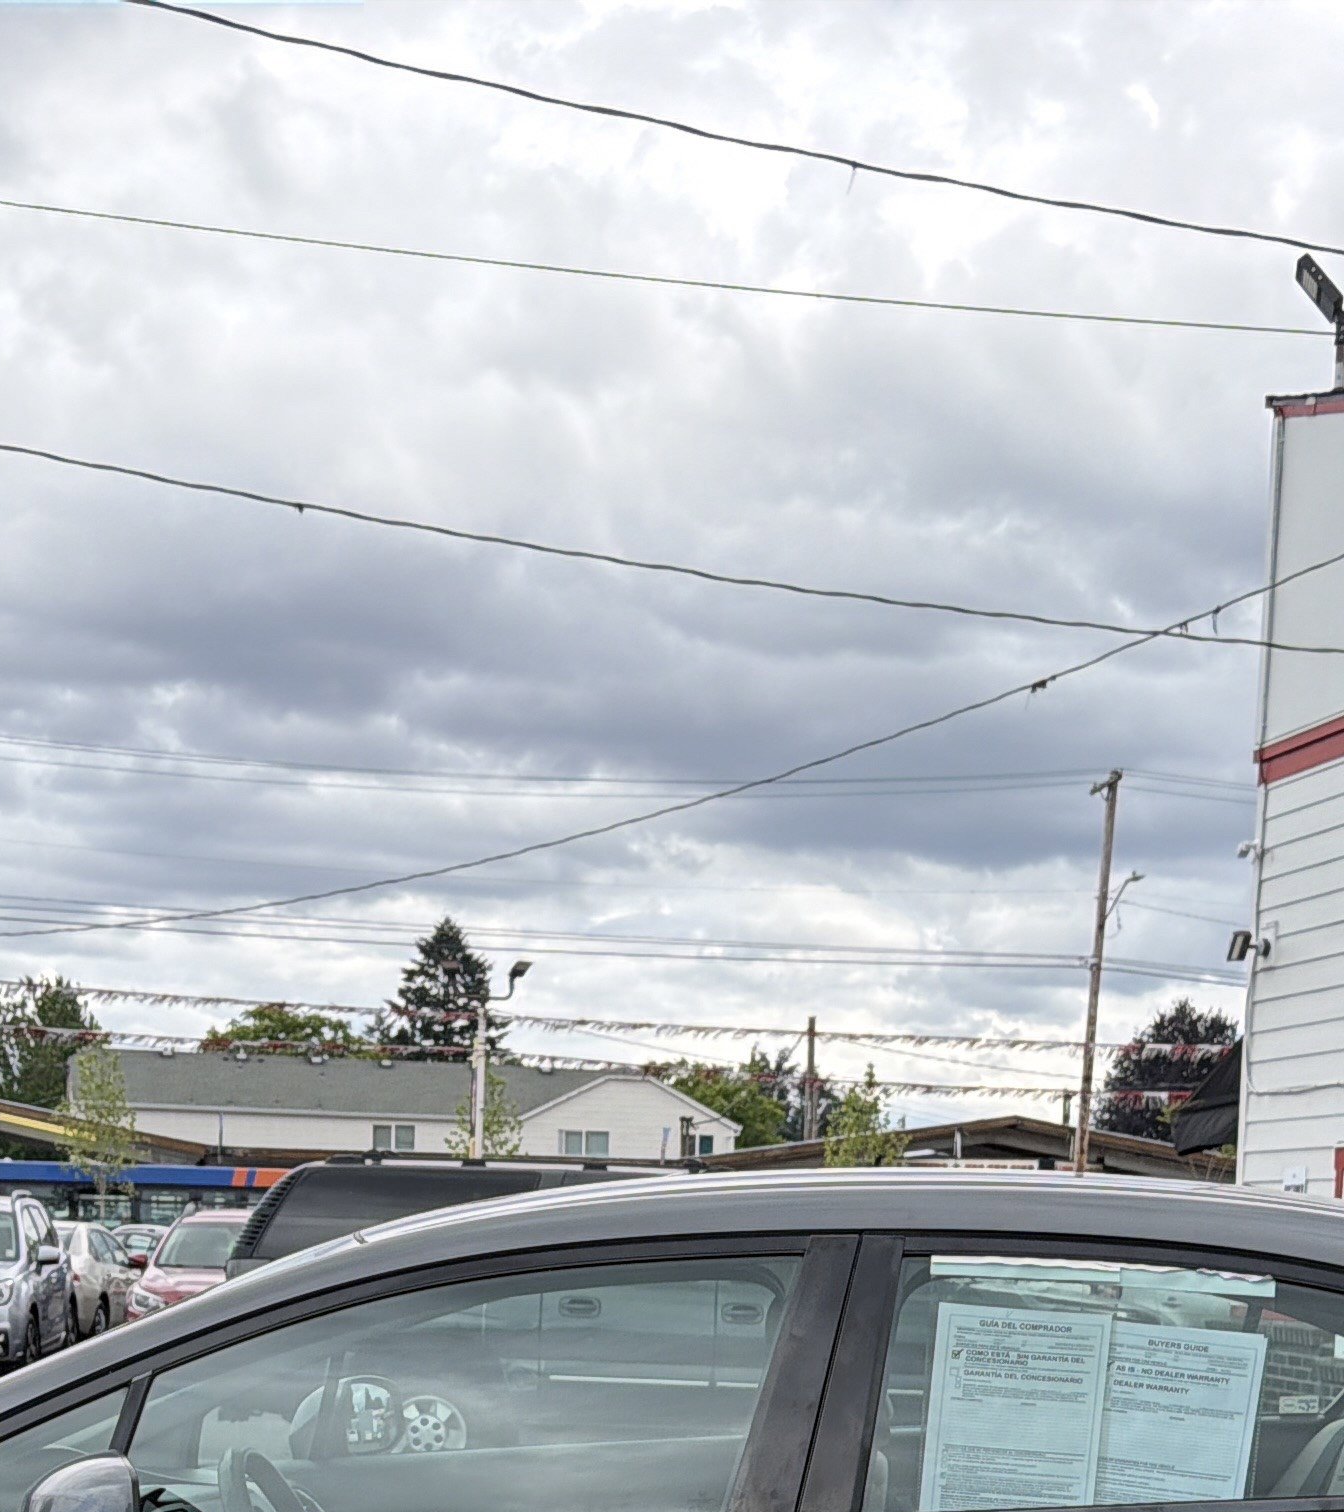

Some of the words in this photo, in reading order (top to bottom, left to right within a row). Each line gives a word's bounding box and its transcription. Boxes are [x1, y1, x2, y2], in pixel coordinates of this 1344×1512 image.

[979, 1319, 999, 1328] GUÍA
[1001, 1321, 1018, 1330] DEL
[1019, 1322, 1073, 1333] COMPRADOR
[1147, 1339, 1181, 1350] BUYERS
[1183, 1343, 1209, 1353] GUIDE
[965, 1349, 989, 1358] COMO
[990, 1350, 1011, 1359] ESTÁ
[1016, 1353, 1030, 1361] SIN
[1030, 1354, 1069, 1364] GARANTÍA
[1070, 1356, 1086, 1364] DEL
[965, 1356, 1028, 1366] CONCESIONARIO
[964, 1369, 1002, 1379] GARANTÍA
[1004, 1372, 1018, 1380] DEL
[1020, 1374, 1084, 1384] CONCESIONARIO
[1115, 1364, 1126, 1372] AS
[1141, 1367, 1153, 1375] NO
[1154, 1369, 1186, 1380] DEALER
[1186, 1373, 1231, 1385] WARRANTY
[1113, 1379, 1145, 1389] DEALER
[1145, 1383, 1190, 1395] WARRANTY
